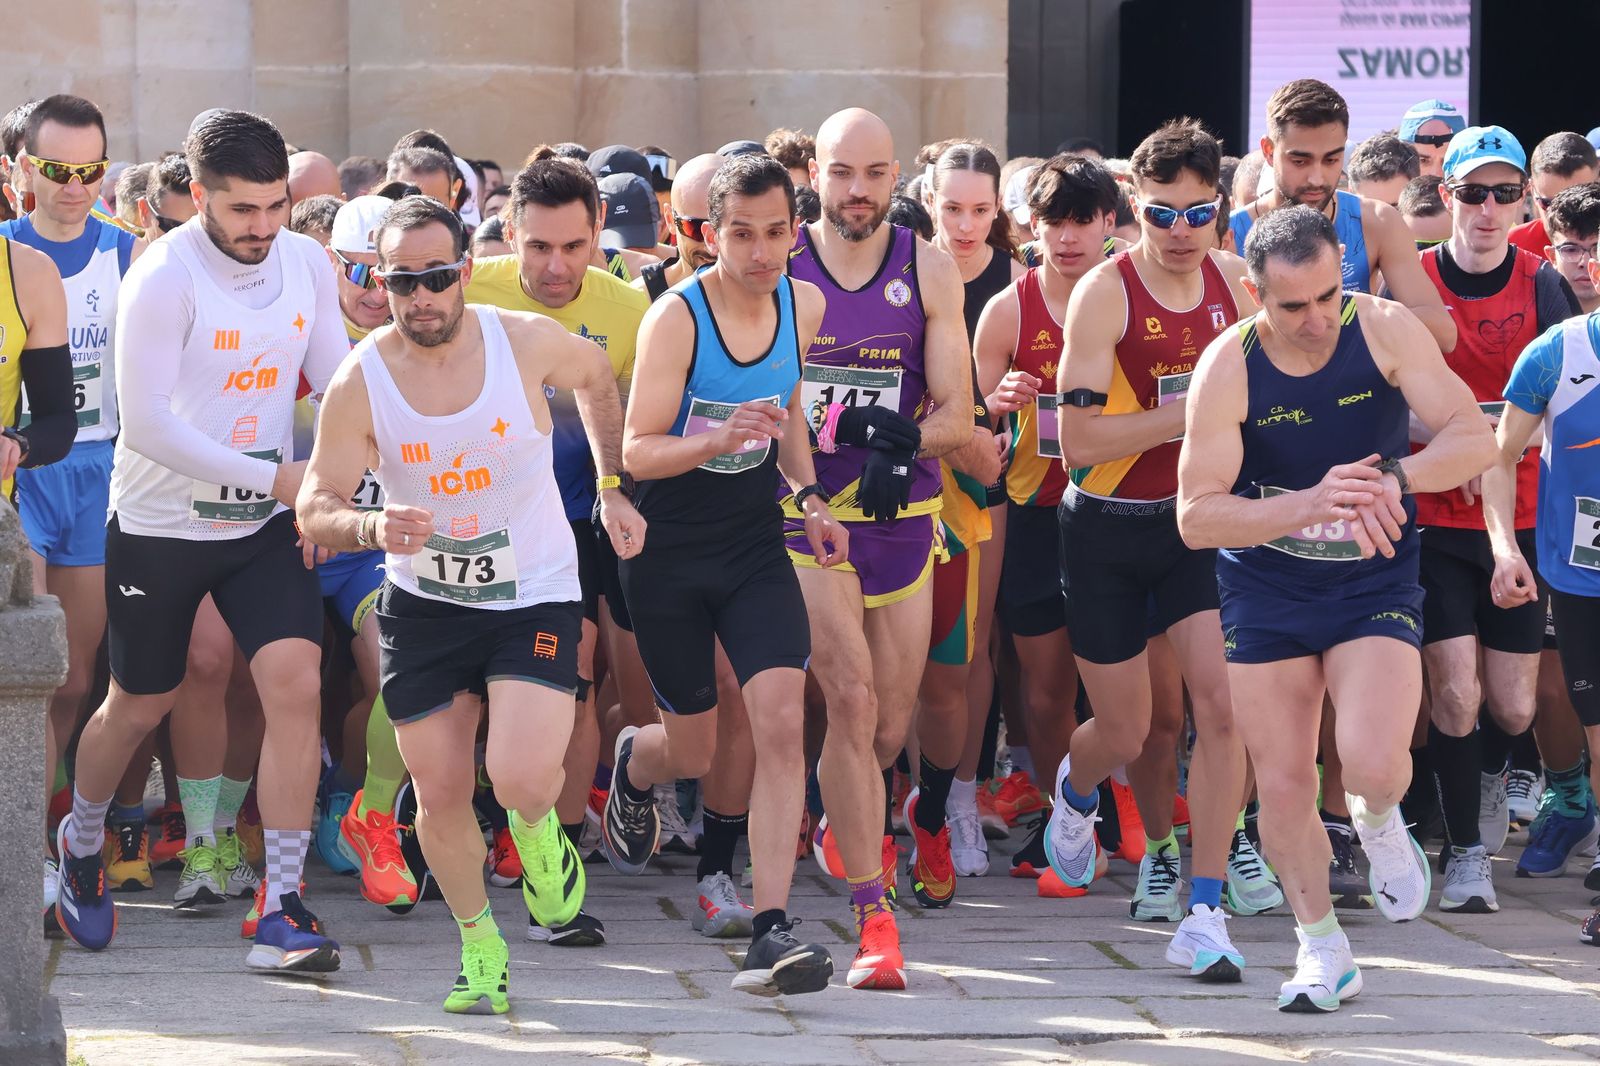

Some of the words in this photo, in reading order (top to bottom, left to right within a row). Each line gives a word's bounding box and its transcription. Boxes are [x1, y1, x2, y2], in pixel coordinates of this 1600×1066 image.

[67, 323, 108, 349] UÑA
[859, 348, 901, 360] PRIM
[1101, 501, 1158, 516] NIKE
[431, 553, 496, 584] 173
